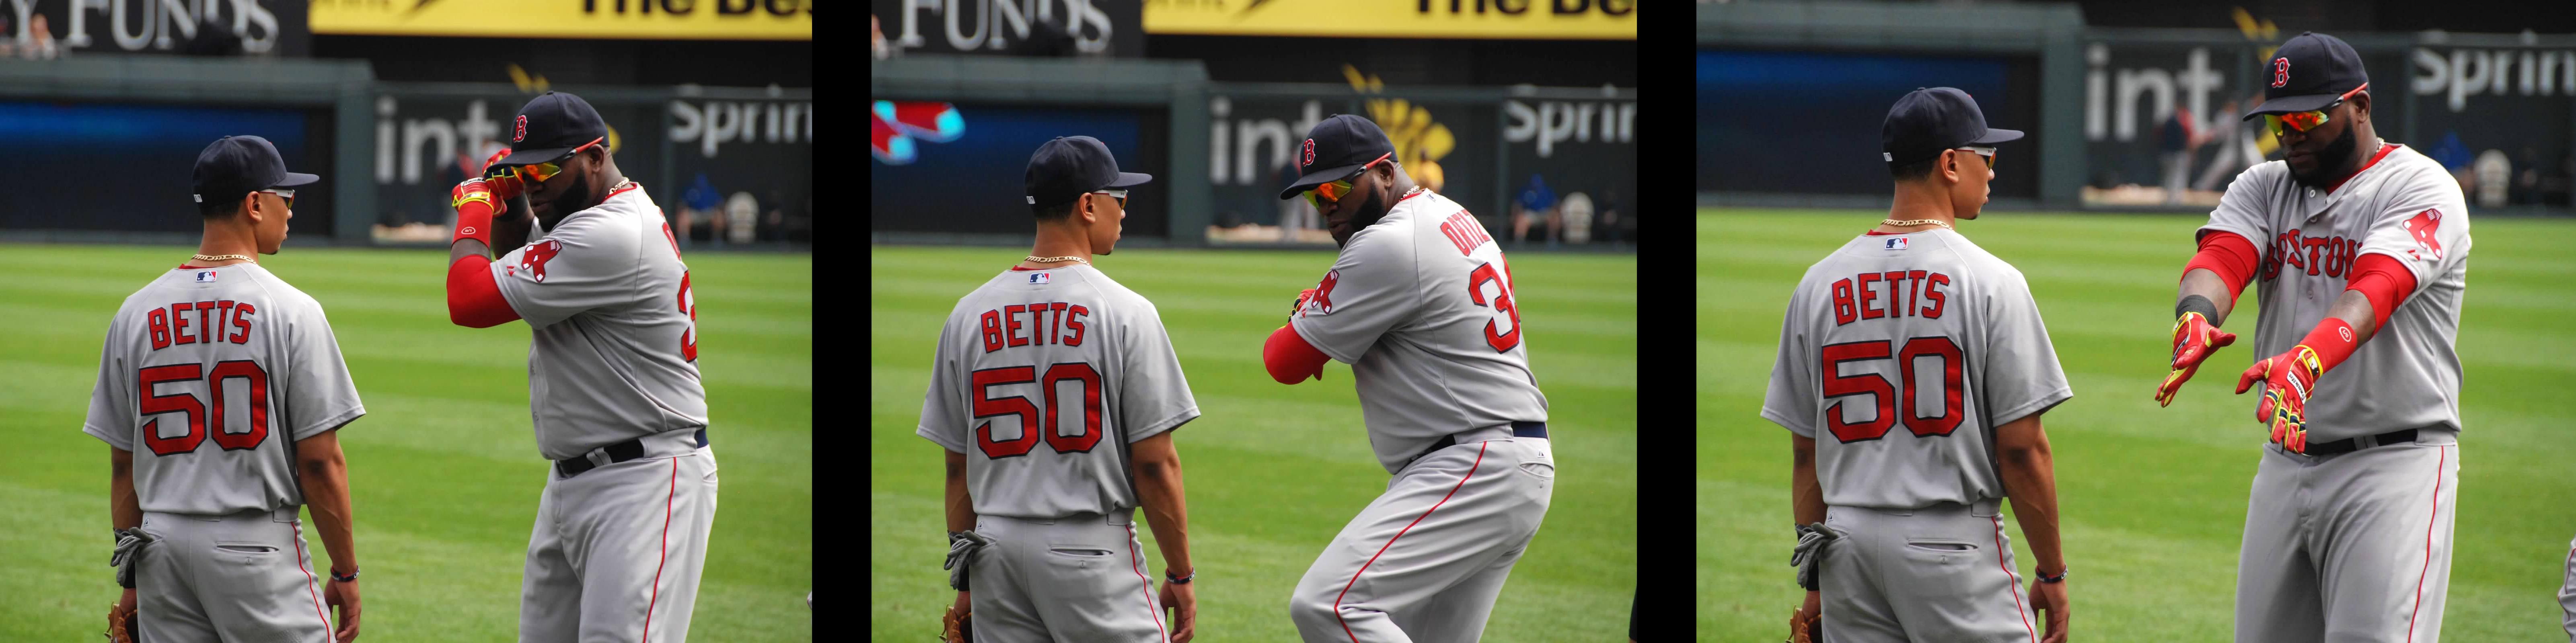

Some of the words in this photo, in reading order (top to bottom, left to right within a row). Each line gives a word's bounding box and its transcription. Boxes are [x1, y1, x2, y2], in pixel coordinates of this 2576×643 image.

[2271, 57, 2290, 88] B
[513, 115, 528, 143] B
[1303, 138, 1316, 167] B
[1440, 209, 1491, 257] ORTIZ
[1832, 270, 1951, 326] BETTS
[148, 300, 256, 351] BETTS
[981, 302, 1089, 353] BETTS
[139, 360, 269, 457] 50
[972, 362, 1103, 460] 50
[1821, 336, 1965, 444] 50
